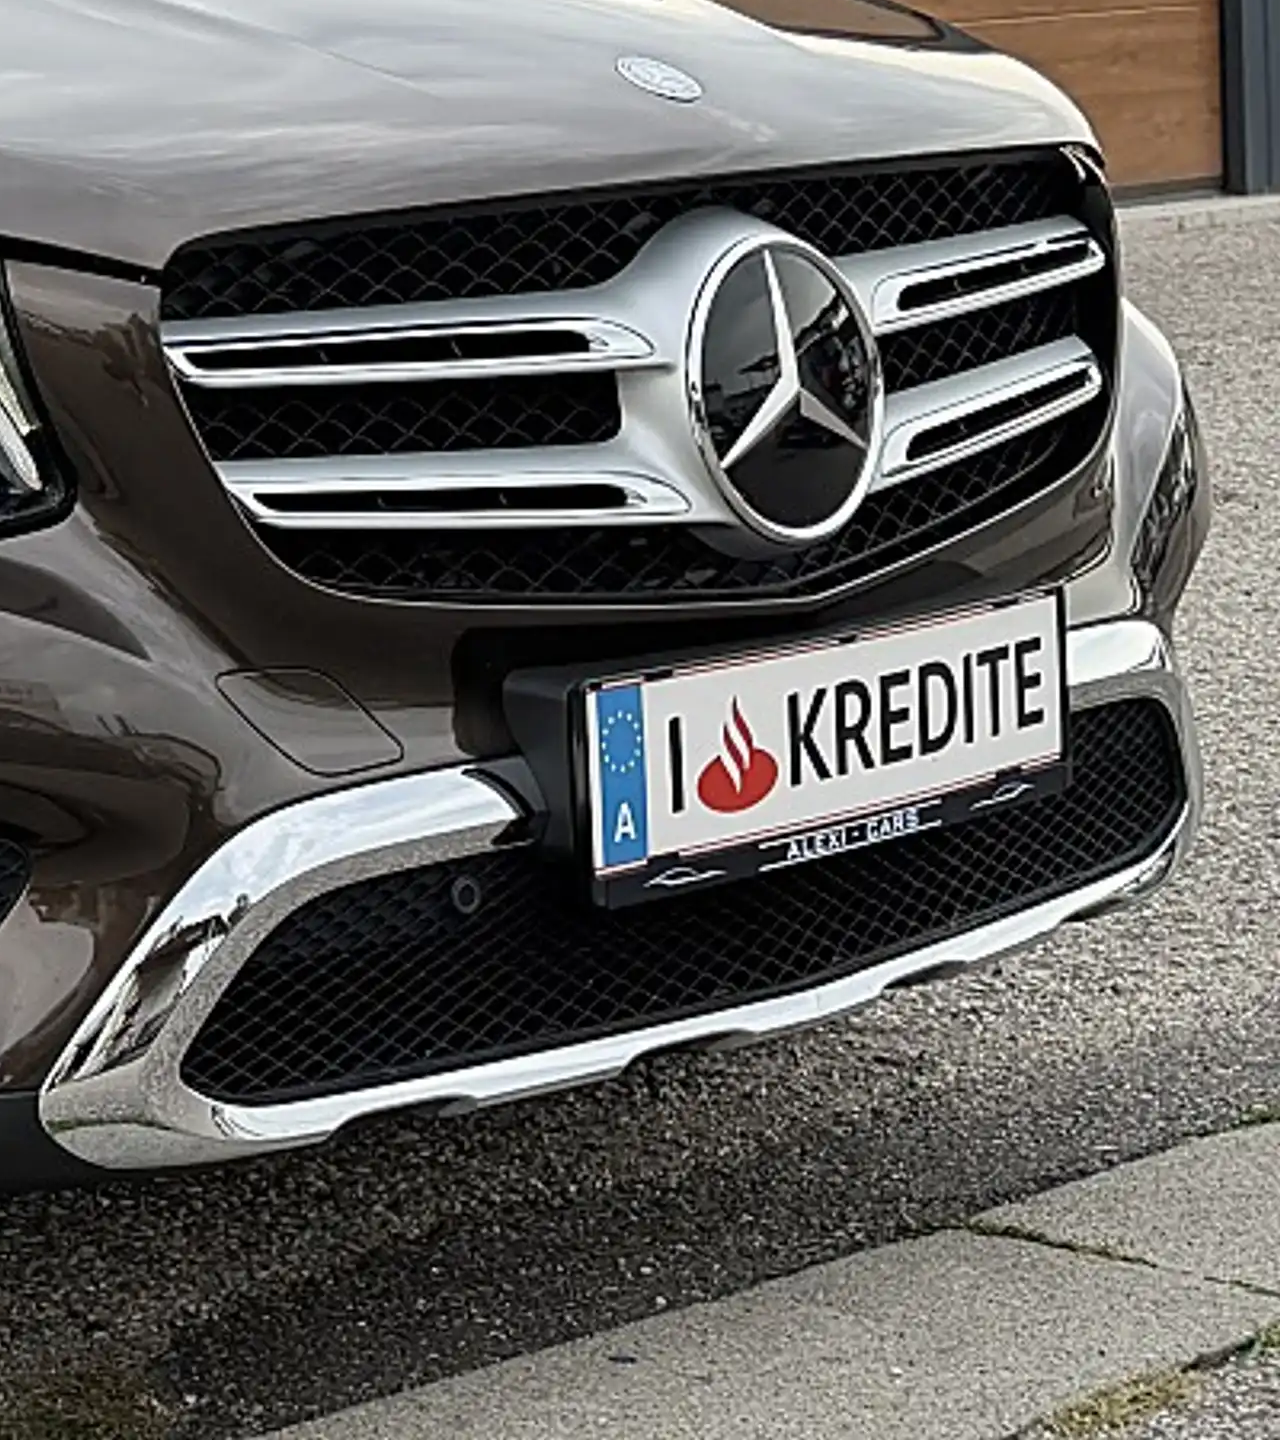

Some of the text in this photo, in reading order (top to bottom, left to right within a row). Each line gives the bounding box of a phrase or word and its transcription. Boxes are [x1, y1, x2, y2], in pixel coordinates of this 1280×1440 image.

[667, 635, 1044, 814] I KREDITE
[613, 802, 637, 844] A
[787, 826, 846, 861] ALEXI
[867, 807, 920, 842] CARS
